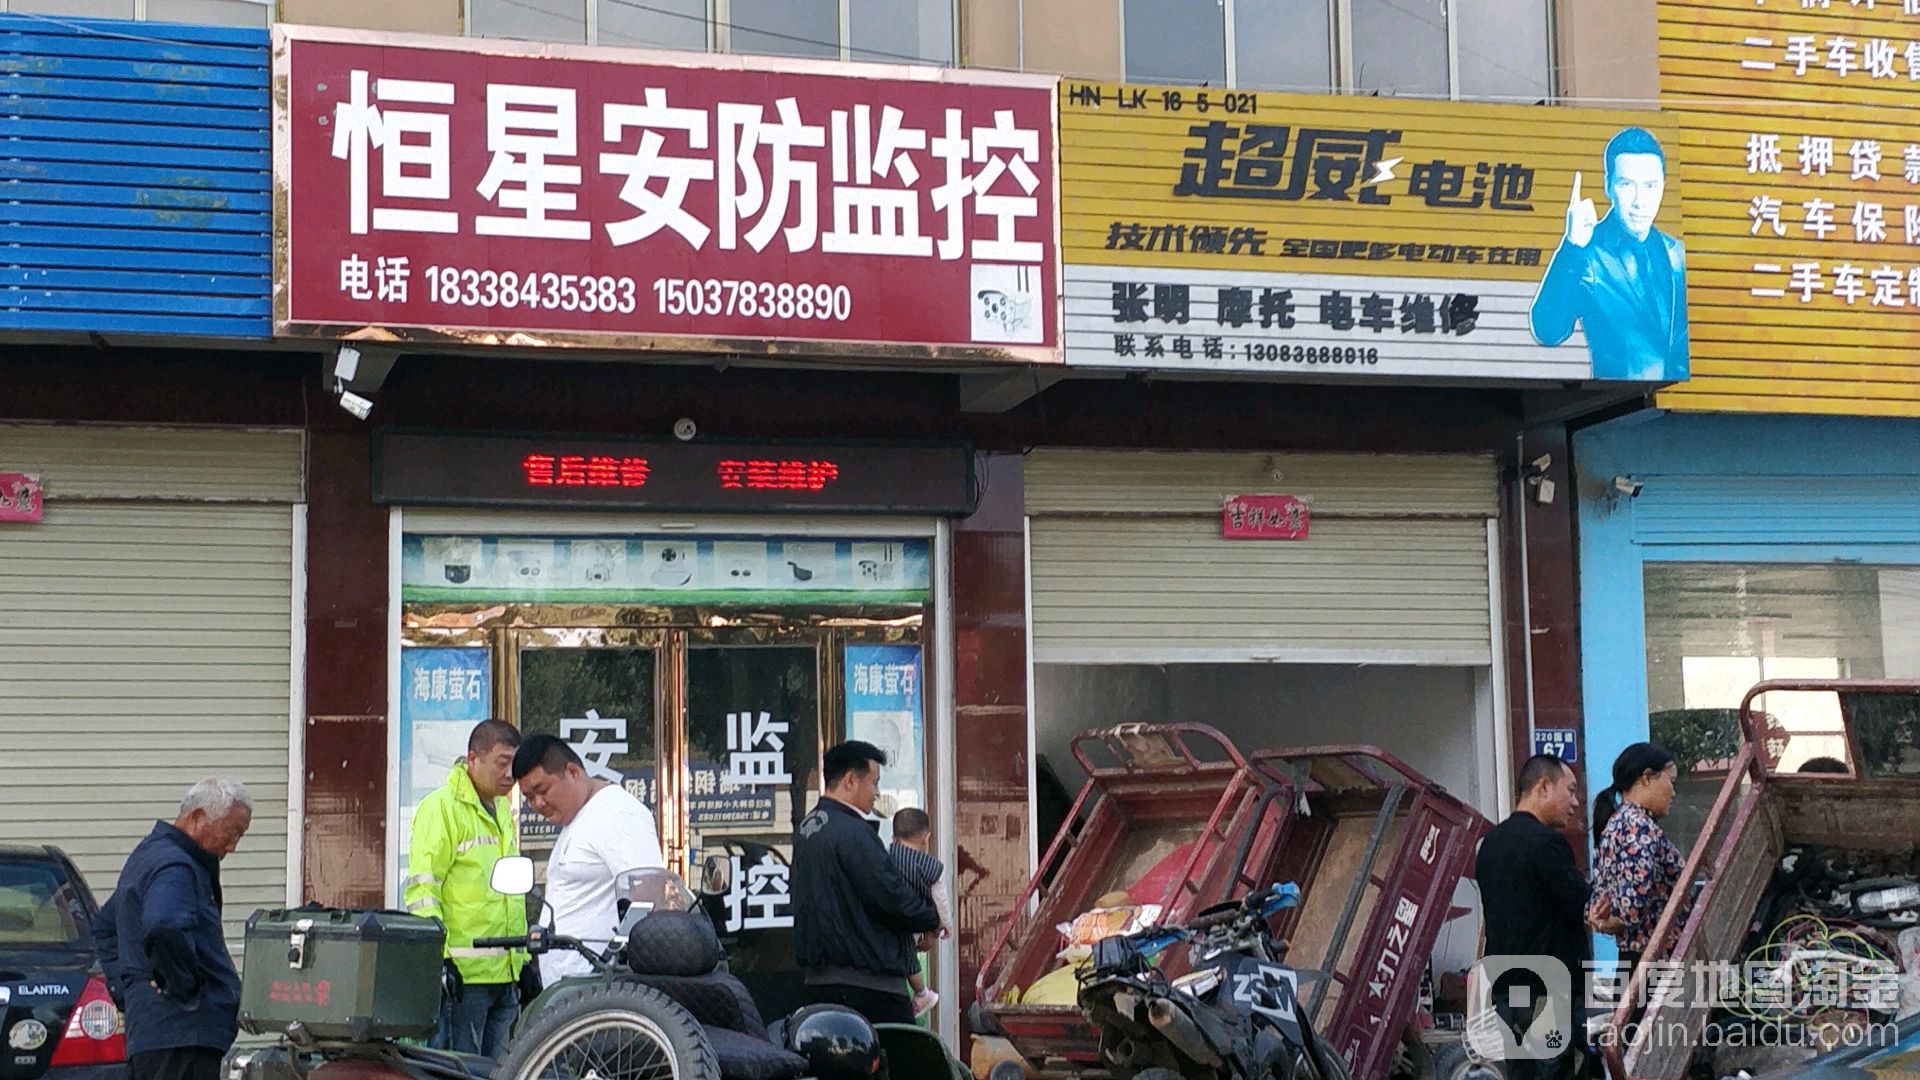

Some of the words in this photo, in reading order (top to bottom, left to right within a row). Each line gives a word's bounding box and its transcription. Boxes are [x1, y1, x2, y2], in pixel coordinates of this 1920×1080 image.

[332, 69, 1044, 262] 恒星安防监控
[1173, 121, 1401, 205] 超威
[1408, 159, 1535, 212] 电池
[1104, 221, 1268, 256] 技术领先
[1282, 238, 1542, 267] 全国更多电动车在用
[339, 253, 411, 303] 电话
[425, 265, 637, 314] 18338435383
[653, 278, 852, 322] 15037838890
[1112, 282, 1190, 324] 张明
[1217, 287, 1296, 329] 摩托
[1319, 290, 1481, 336] 电车维修
[1228, 502, 1304, 532] 吉祥如意
[413, 667, 482, 703] 海康萤石
[853, 662, 915, 697] 海康萤石
[559, 708, 629, 784] 安
[726, 711, 793, 785] 监
[1543, 742, 1565, 758] 67
[723, 855, 796, 933] 控
[18, 985, 70, 995] ELANTRA
